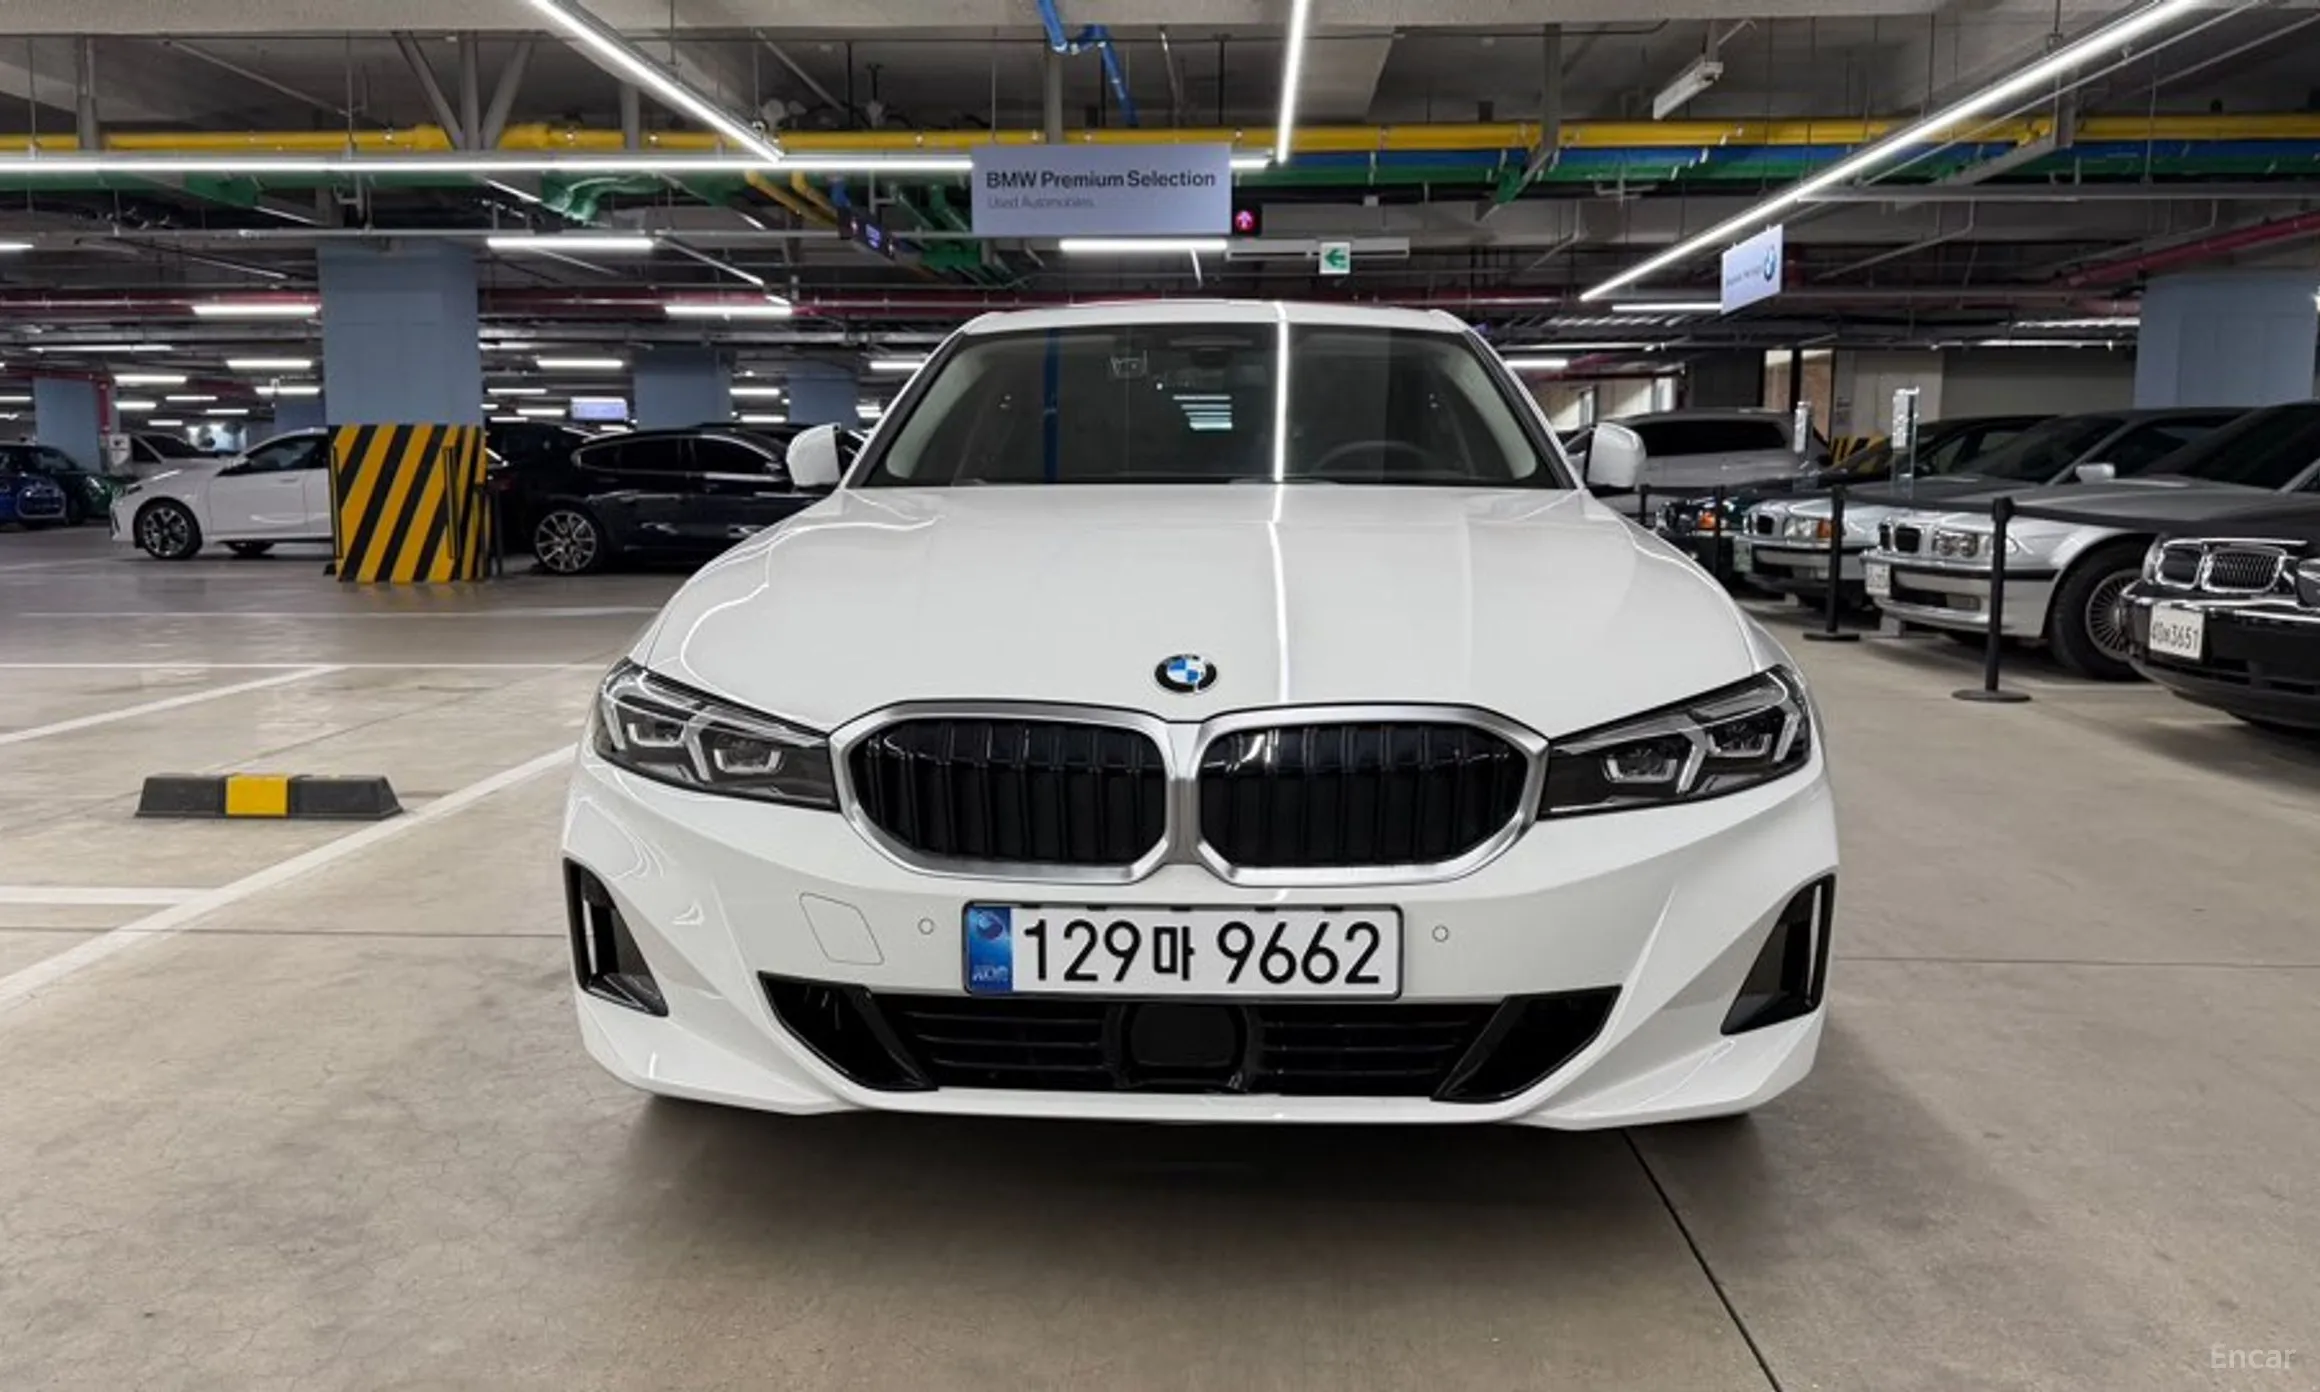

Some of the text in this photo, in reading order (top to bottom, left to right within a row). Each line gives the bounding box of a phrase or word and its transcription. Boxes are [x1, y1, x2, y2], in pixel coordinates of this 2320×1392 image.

[985, 169, 1217, 189] BMW Premium Selection
[1023, 918, 1381, 985] 129마 9662
